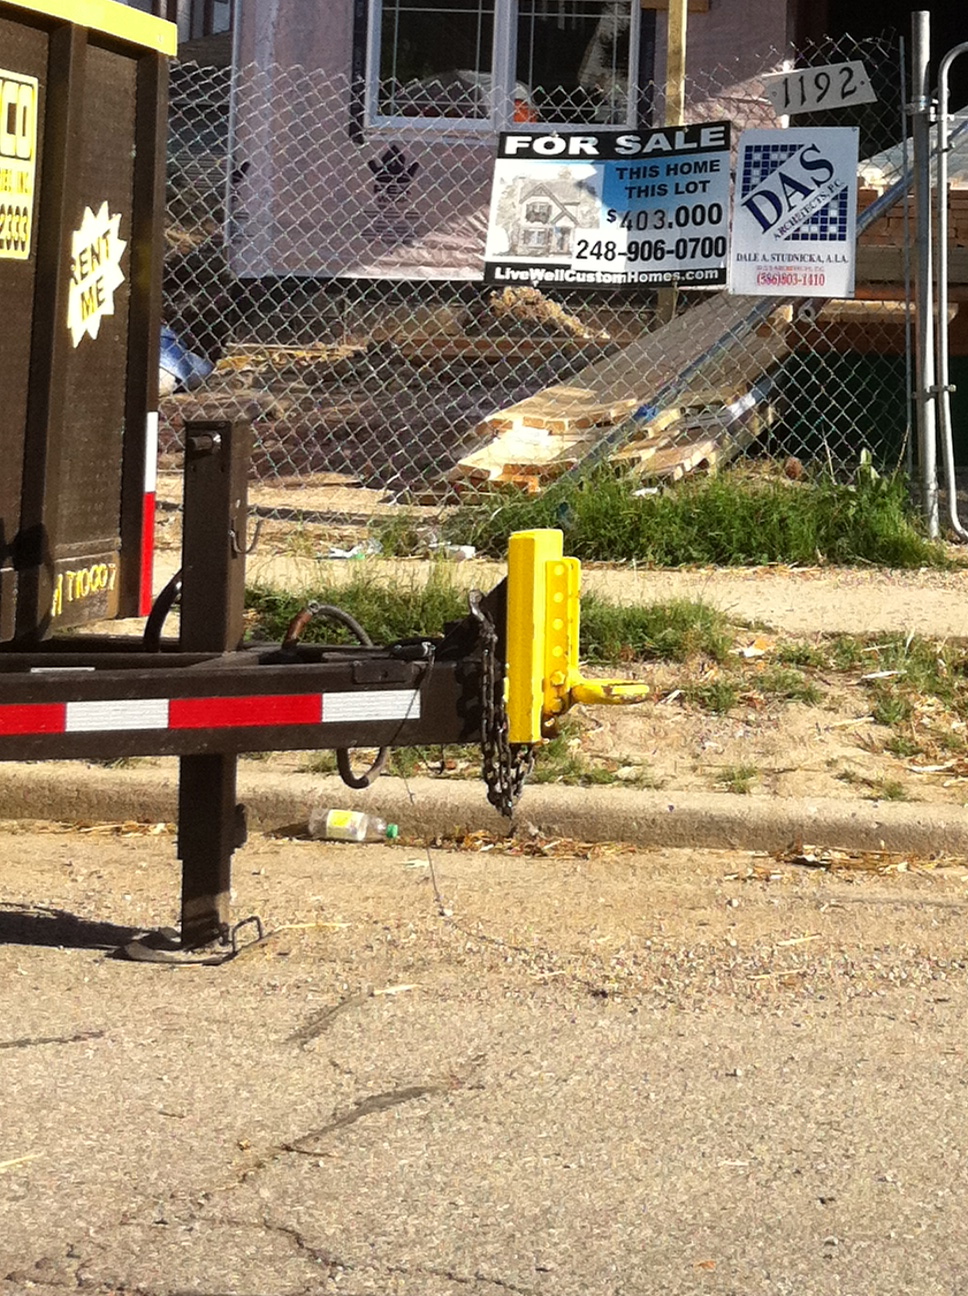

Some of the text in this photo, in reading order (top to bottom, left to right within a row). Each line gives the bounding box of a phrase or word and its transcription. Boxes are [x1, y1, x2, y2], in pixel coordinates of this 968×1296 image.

[782, 66, 857, 108] 1192
[505, 126, 726, 155] FOR SALE
[615, 160, 721, 180] THIS HOME
[625, 180, 711, 198] THIS LOT
[741, 143, 834, 234] DAS
[576, 236, 727, 262] 248-906-0700
[735, 253, 759, 262] DALE
[770, 253, 825, 264] STUDNICKA,
[495, 267, 719, 284] LiveWellCustomHomes.com
[81, 275, 106, 322] ME
